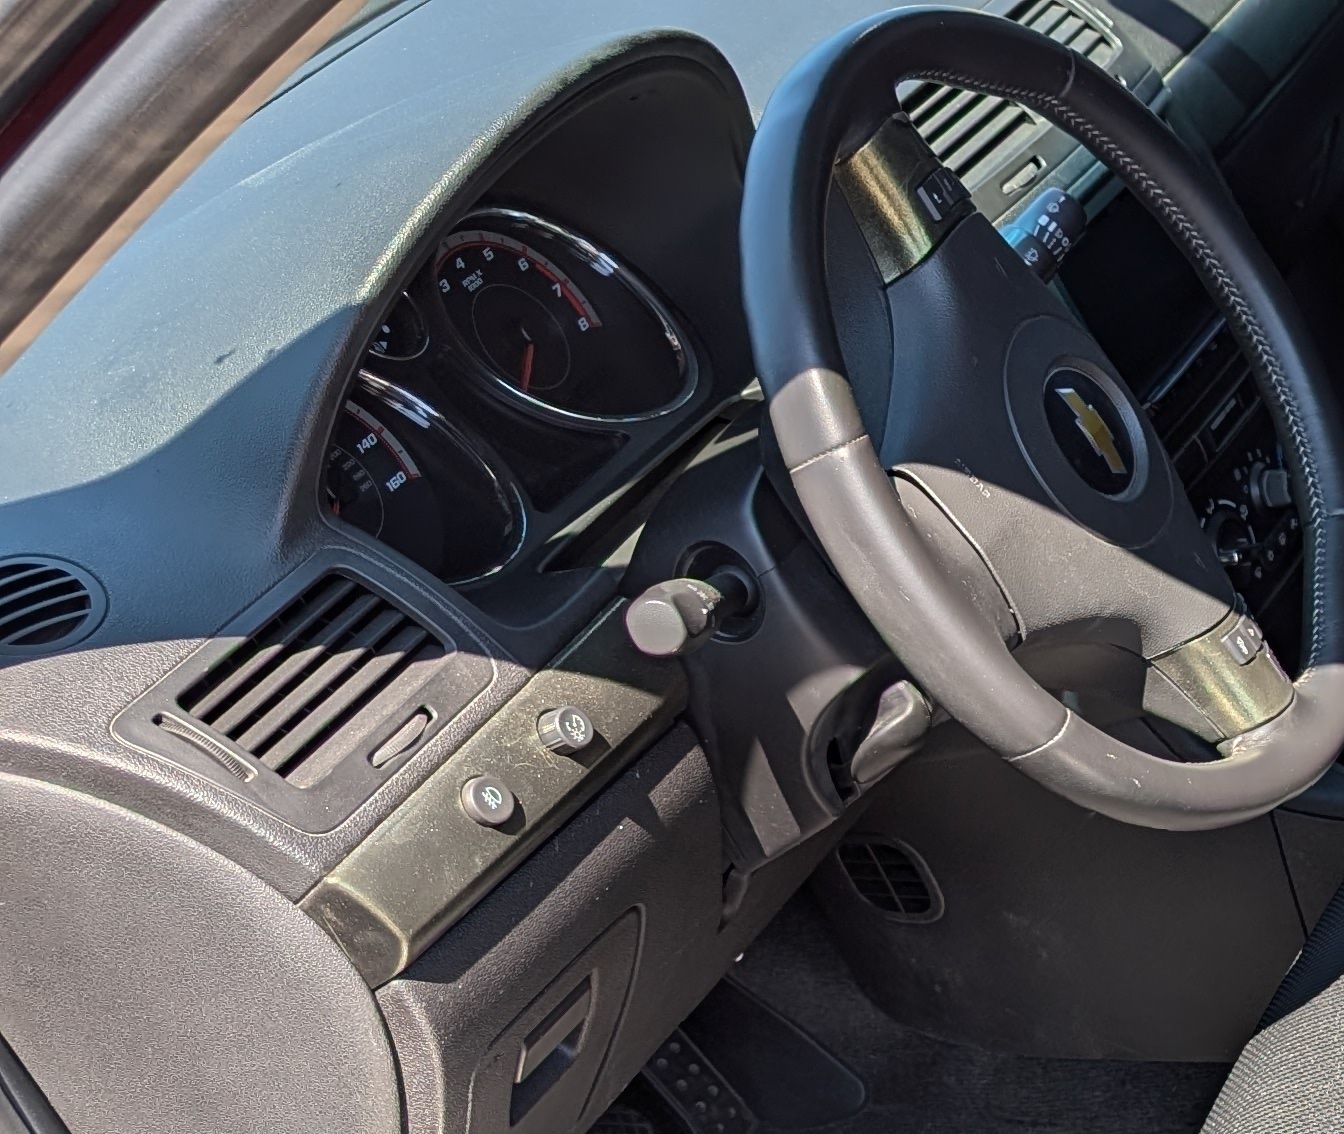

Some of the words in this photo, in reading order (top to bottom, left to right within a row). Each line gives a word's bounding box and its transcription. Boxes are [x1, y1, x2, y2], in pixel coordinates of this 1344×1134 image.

[482, 247, 495, 261] 5
[455, 257, 466, 269] 4
[517, 257, 530, 271] 6
[439, 278, 450, 293] 3
[551, 283, 562, 298] 7
[577, 317, 590, 332] 8
[356, 432, 378, 454] 140
[385, 471, 407, 492] 160
